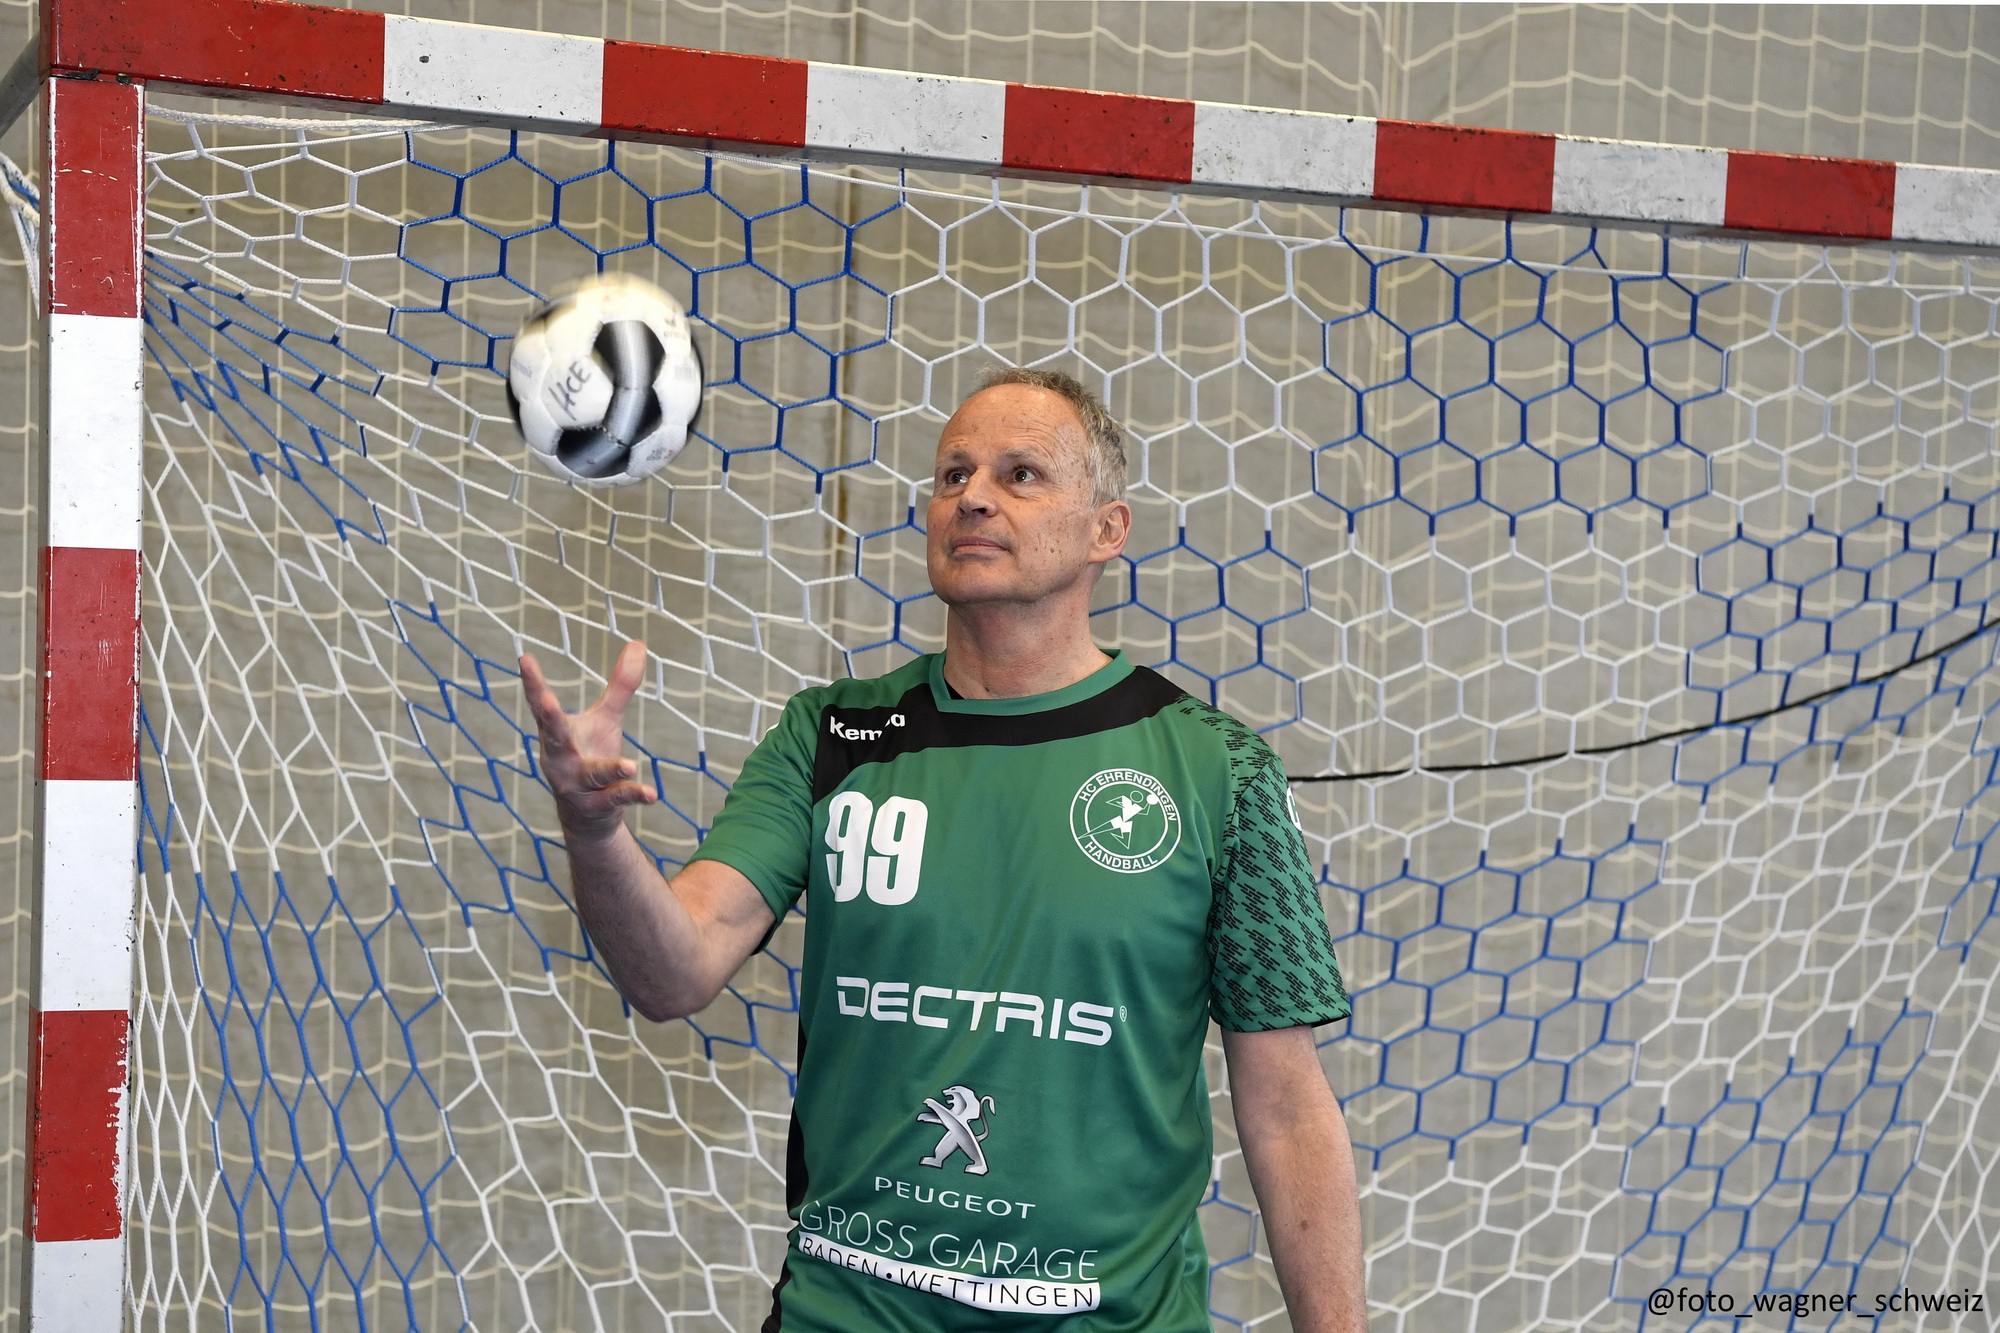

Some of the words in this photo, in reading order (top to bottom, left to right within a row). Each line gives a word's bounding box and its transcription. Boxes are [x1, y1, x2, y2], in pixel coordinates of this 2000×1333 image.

[830, 713, 906, 741] kema
[1079, 783, 1098, 802] HC
[1095, 771, 1177, 821] EHRENDINGEN
[824, 791, 928, 906] 99
[1084, 841, 1158, 870] HANDBALL
[874, 1176, 1036, 1219] PEUGEOT
[799, 1199, 917, 1259] GROSS
[929, 1233, 1099, 1281] GARAGE
[900, 1267, 1093, 1307] WETTINGEN
